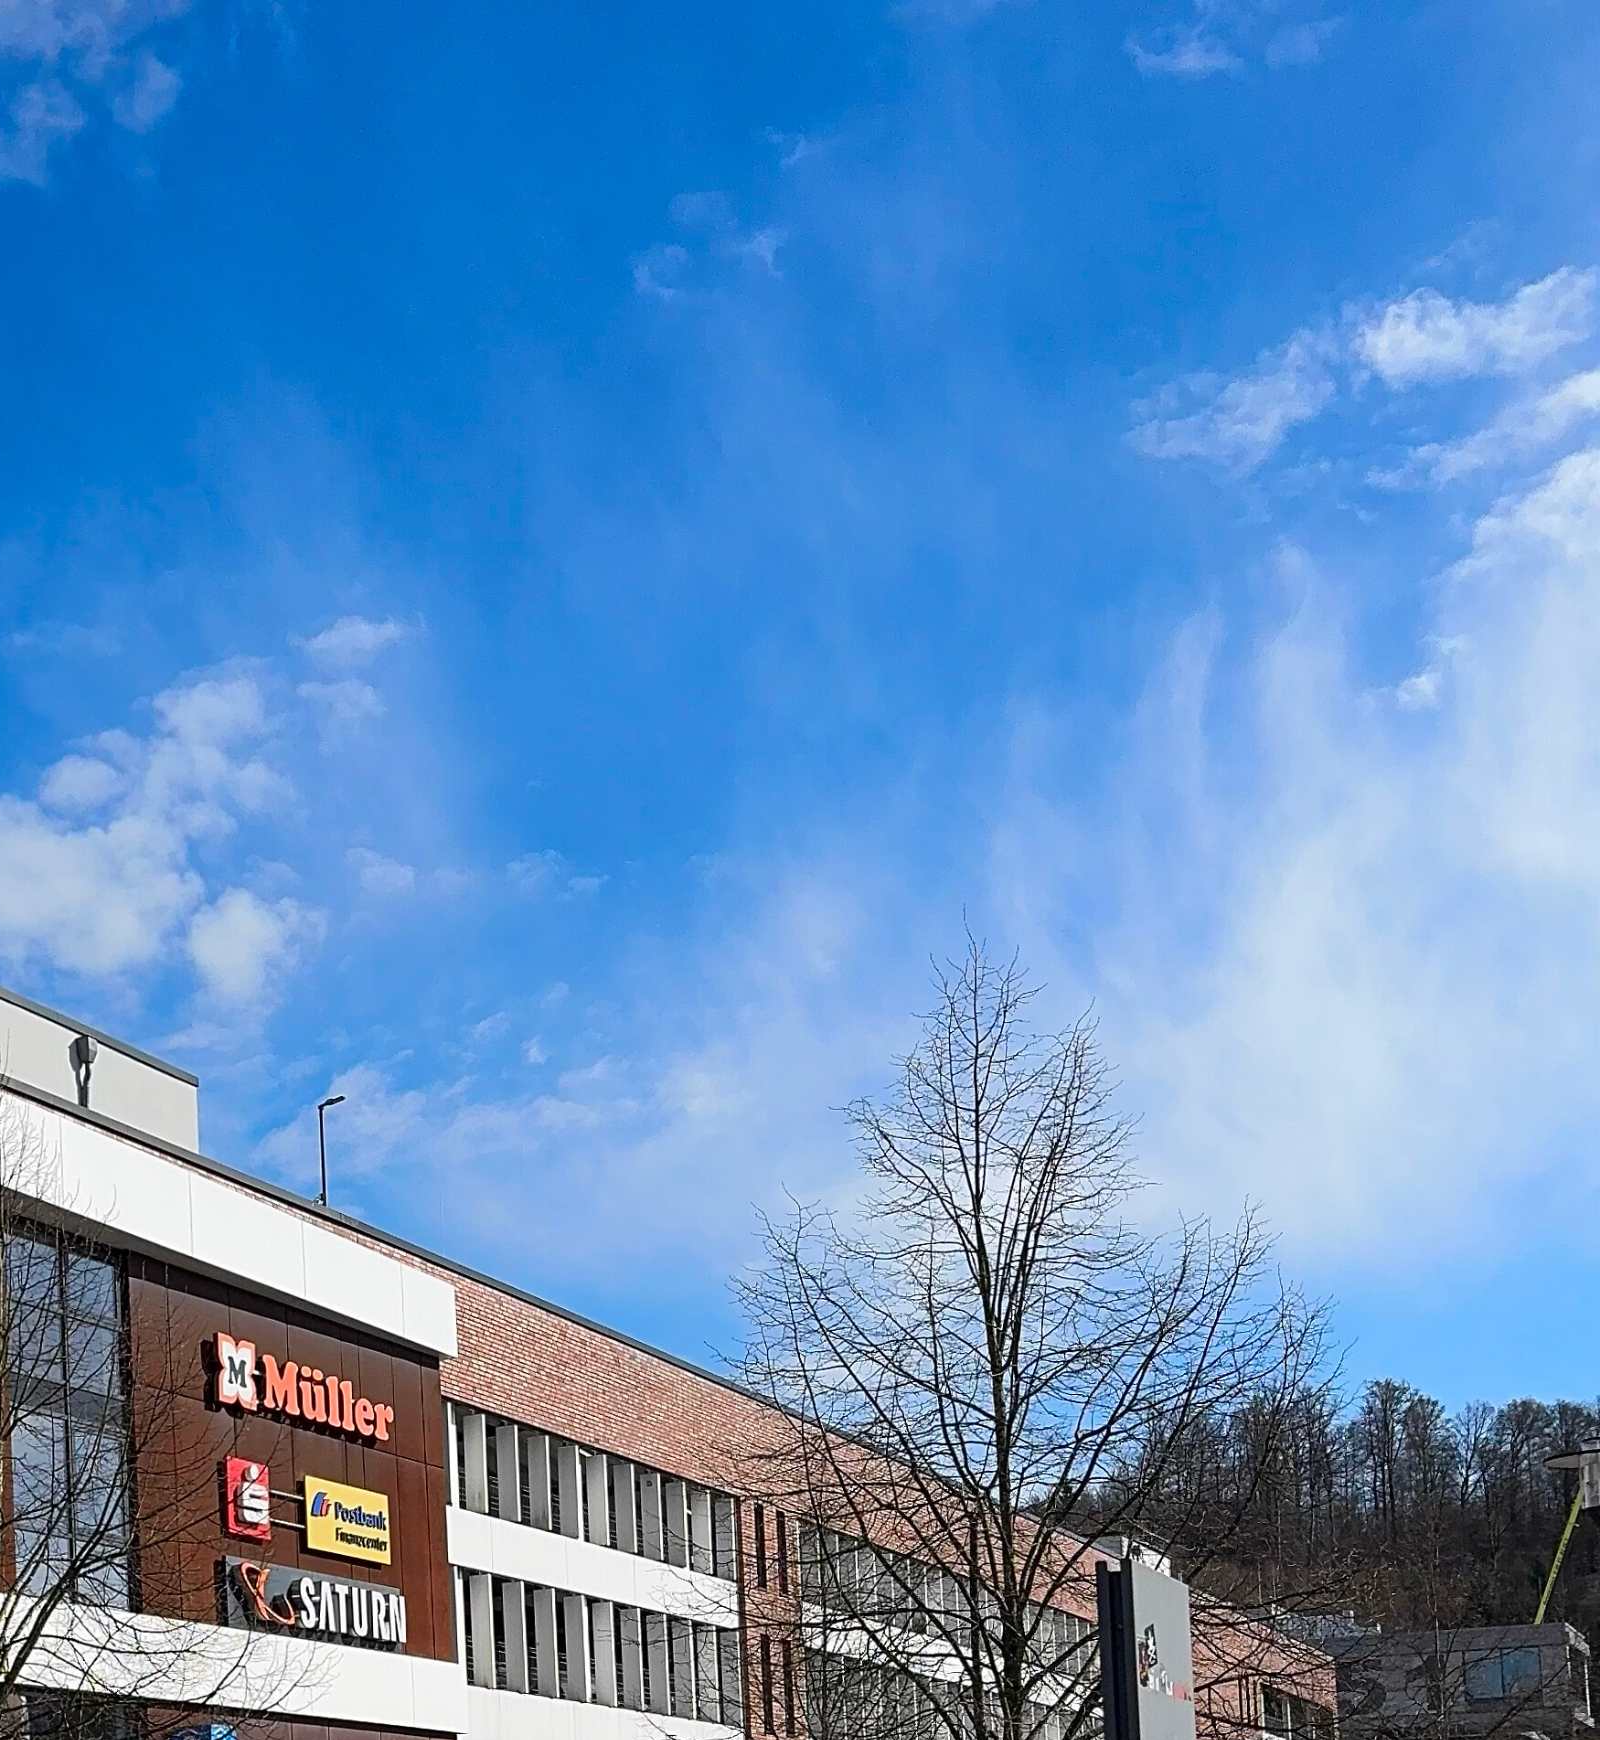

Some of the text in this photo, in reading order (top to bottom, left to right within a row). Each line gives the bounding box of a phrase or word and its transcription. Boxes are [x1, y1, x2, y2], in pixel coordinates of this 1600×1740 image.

[262, 1354, 394, 1441] Müller
[334, 1501, 387, 1532] Postbank
[335, 1527, 388, 1552] Finanzcenter
[300, 1576, 408, 1643] SATURN
